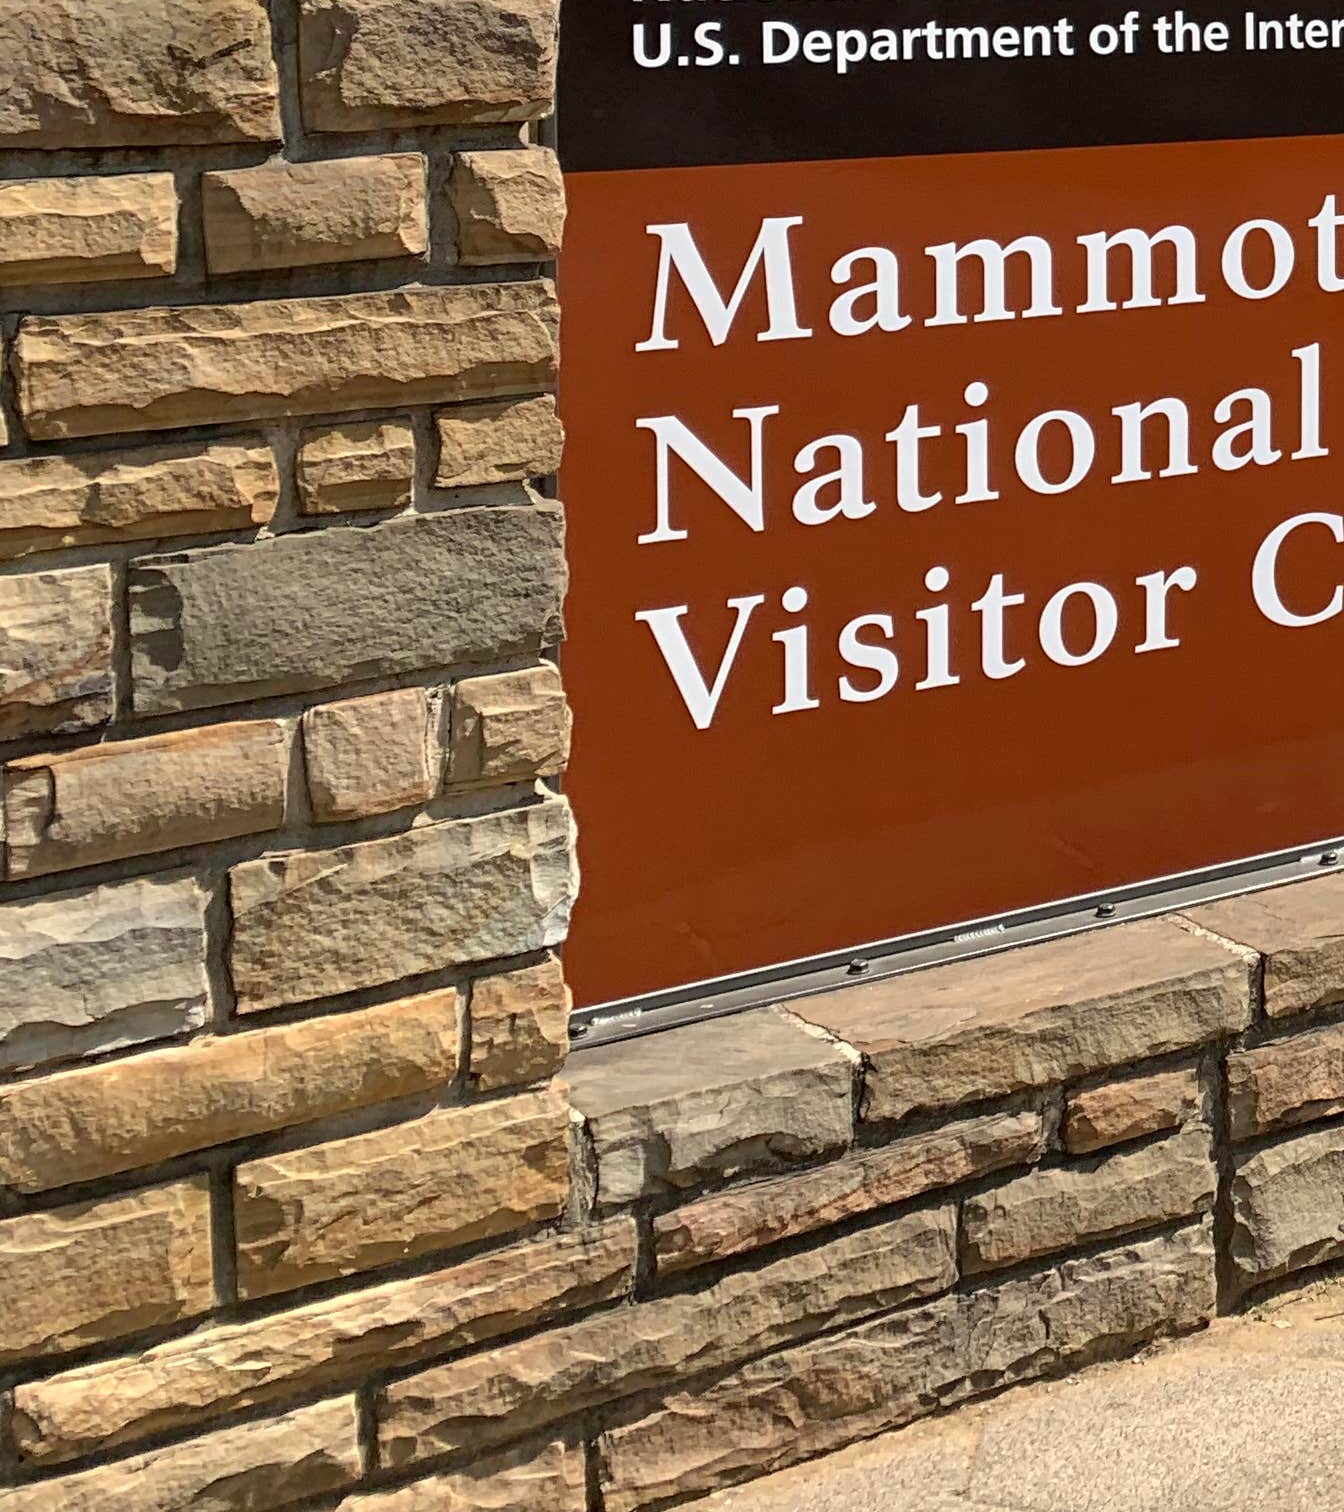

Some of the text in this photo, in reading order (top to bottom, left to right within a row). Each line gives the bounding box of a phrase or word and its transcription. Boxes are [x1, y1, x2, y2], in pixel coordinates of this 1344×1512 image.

[632, 21, 740, 68] U.S.
[762, 17, 1075, 74] Department
[1088, 10, 1140, 55] of
[1152, 10, 1229, 53] the
[635, 342, 1329, 546] National
[634, 565, 1197, 731] Visitor
